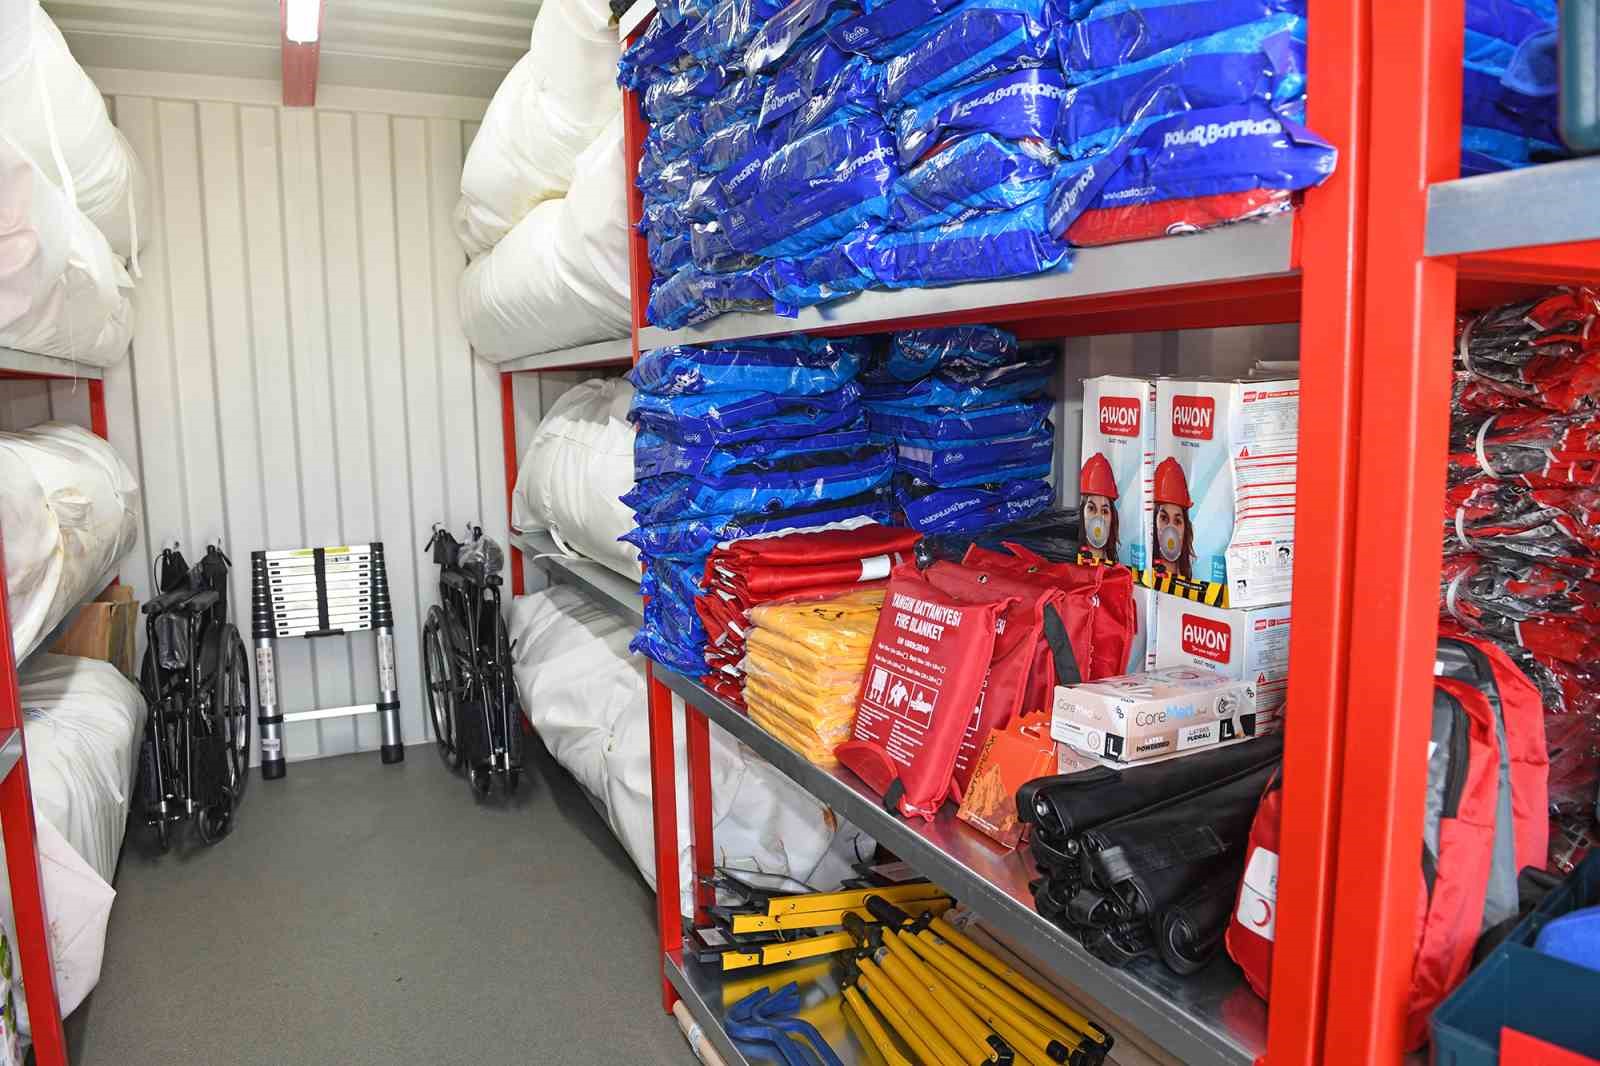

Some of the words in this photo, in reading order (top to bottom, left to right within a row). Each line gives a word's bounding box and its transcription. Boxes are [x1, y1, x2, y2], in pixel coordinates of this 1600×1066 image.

[1100, 406, 1138, 426] AWON
[1173, 405, 1212, 428] AWON
[908, 617, 945, 641] BLANKET
[1183, 623, 1228, 652] AWON
[1221, 721, 1233, 738] L
[1107, 737, 1119, 757] L
